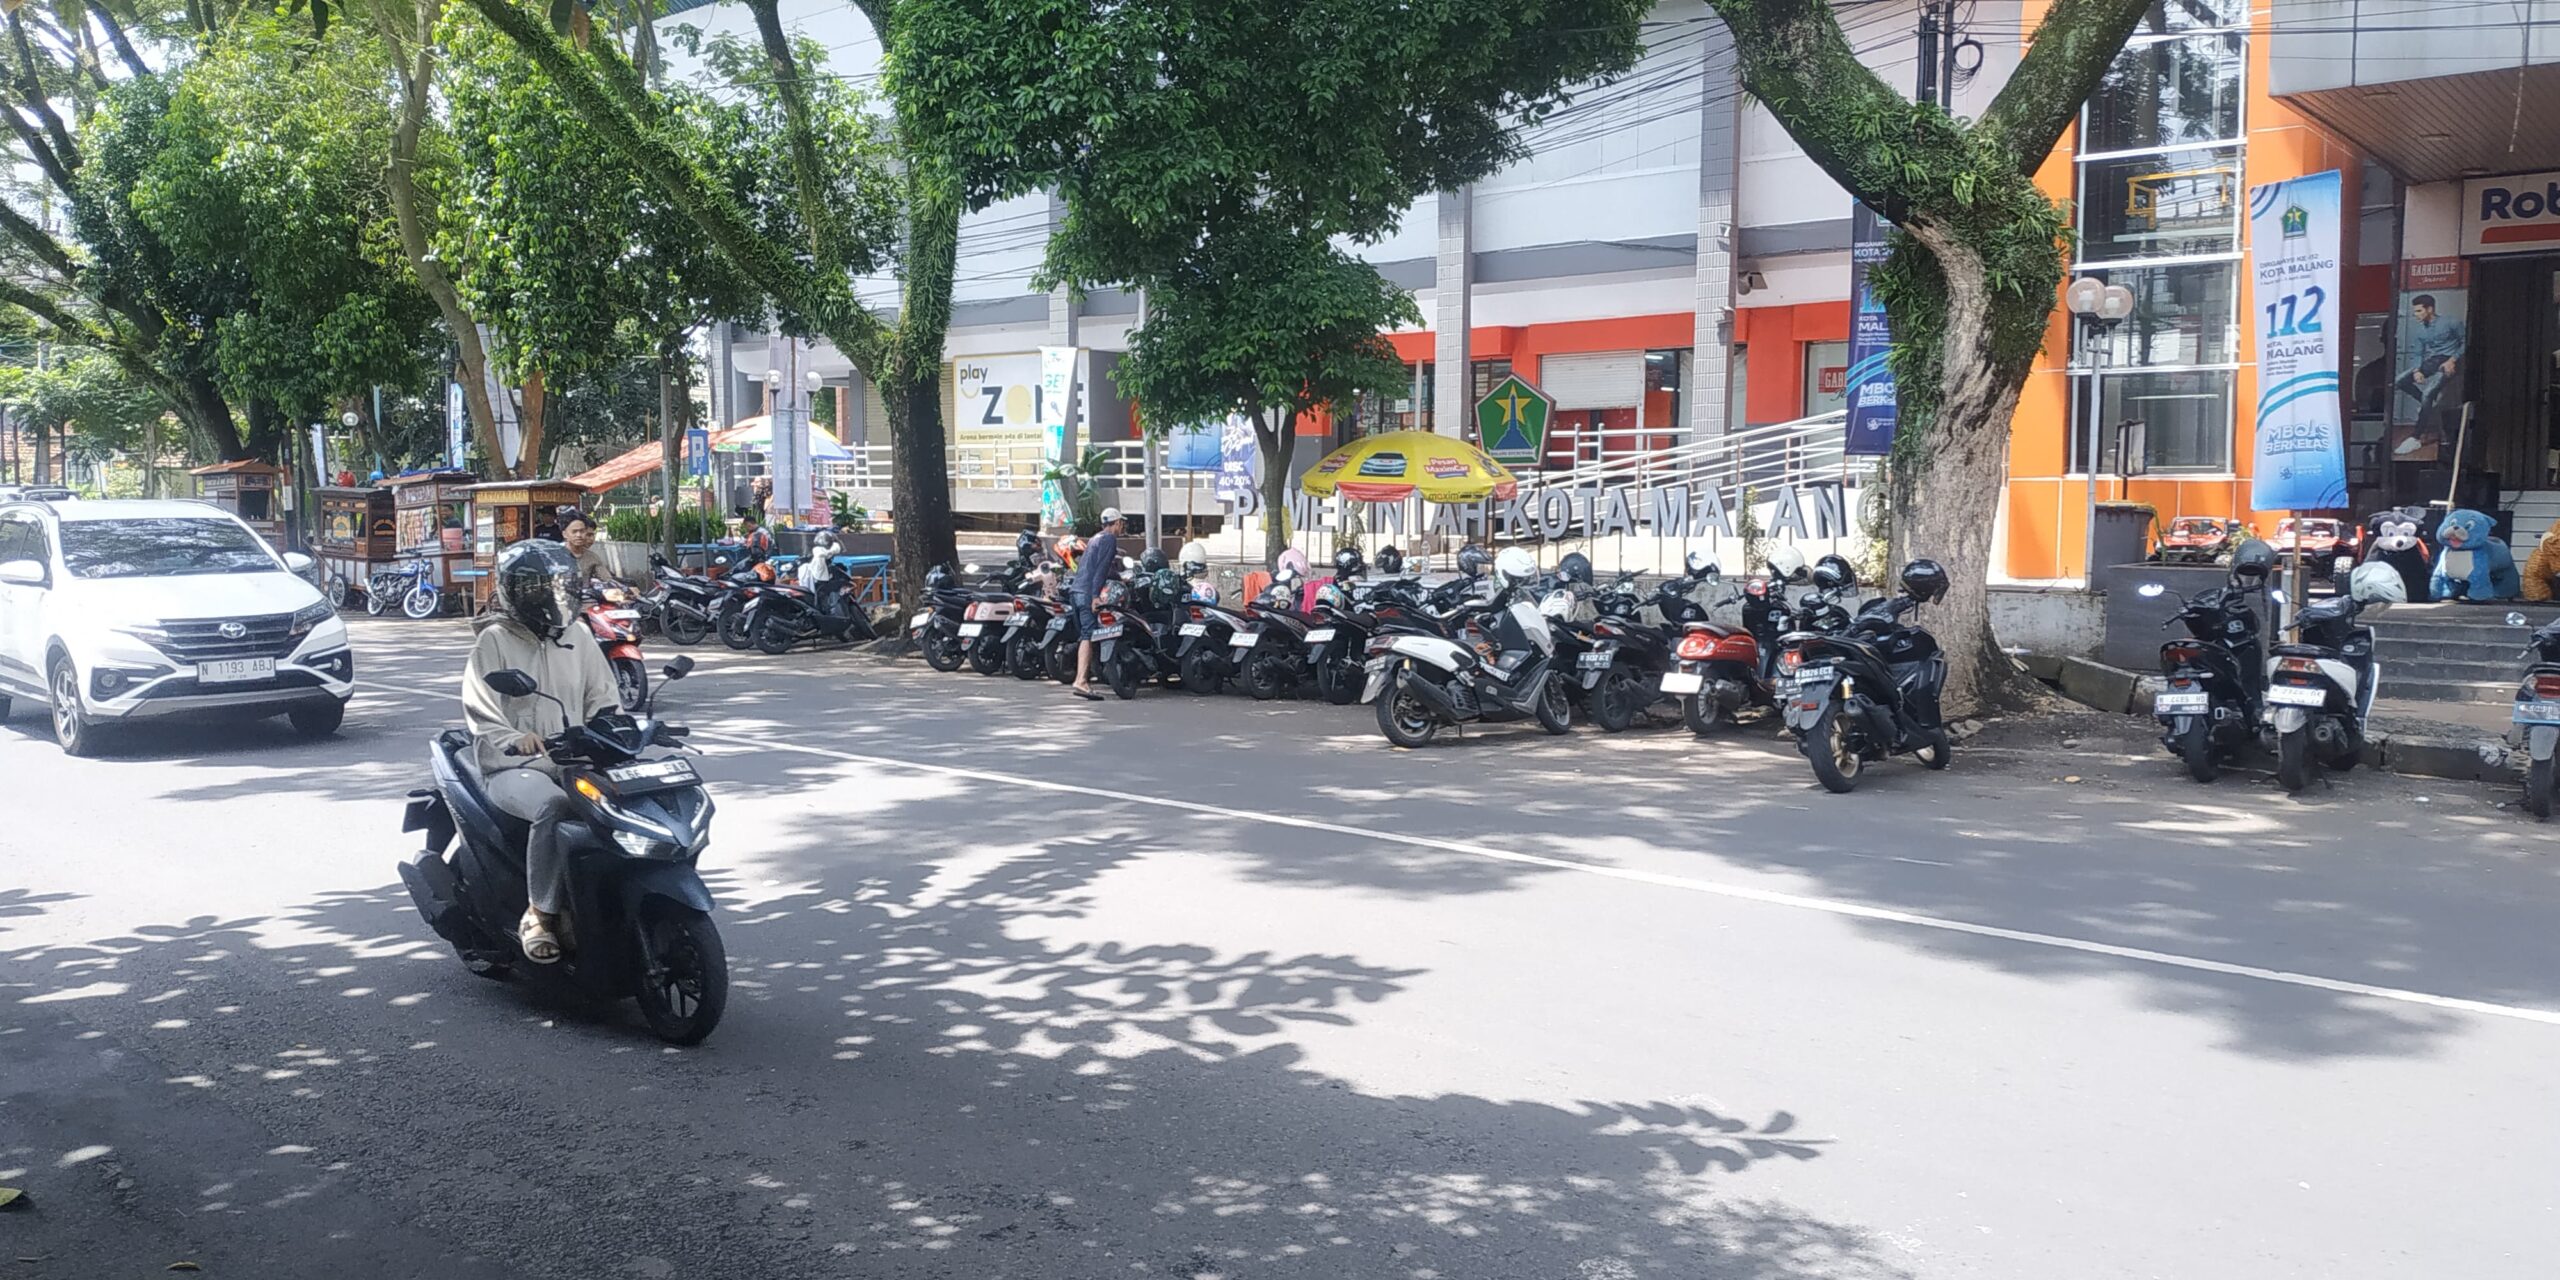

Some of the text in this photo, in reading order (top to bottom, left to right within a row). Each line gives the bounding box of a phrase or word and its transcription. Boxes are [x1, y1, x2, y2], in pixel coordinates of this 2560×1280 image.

[1854, 248, 1880, 257] KOTA
[2259, 266, 2286, 280] KOTA
[2288, 259, 2334, 275] MALANG
[2266, 285, 2326, 339] 112
[1858, 322, 1889, 332] MAL
[960, 364, 988, 384] play
[1825, 371, 1847, 388] GAB
[1860, 382, 1895, 396] MBO
[1430, 458, 1457, 466] Pesan
[1233, 488, 1486, 537] PMERINAH
[1504, 487, 1636, 539] KOTA
[202, 659, 273, 676] N 1193 ABJ
